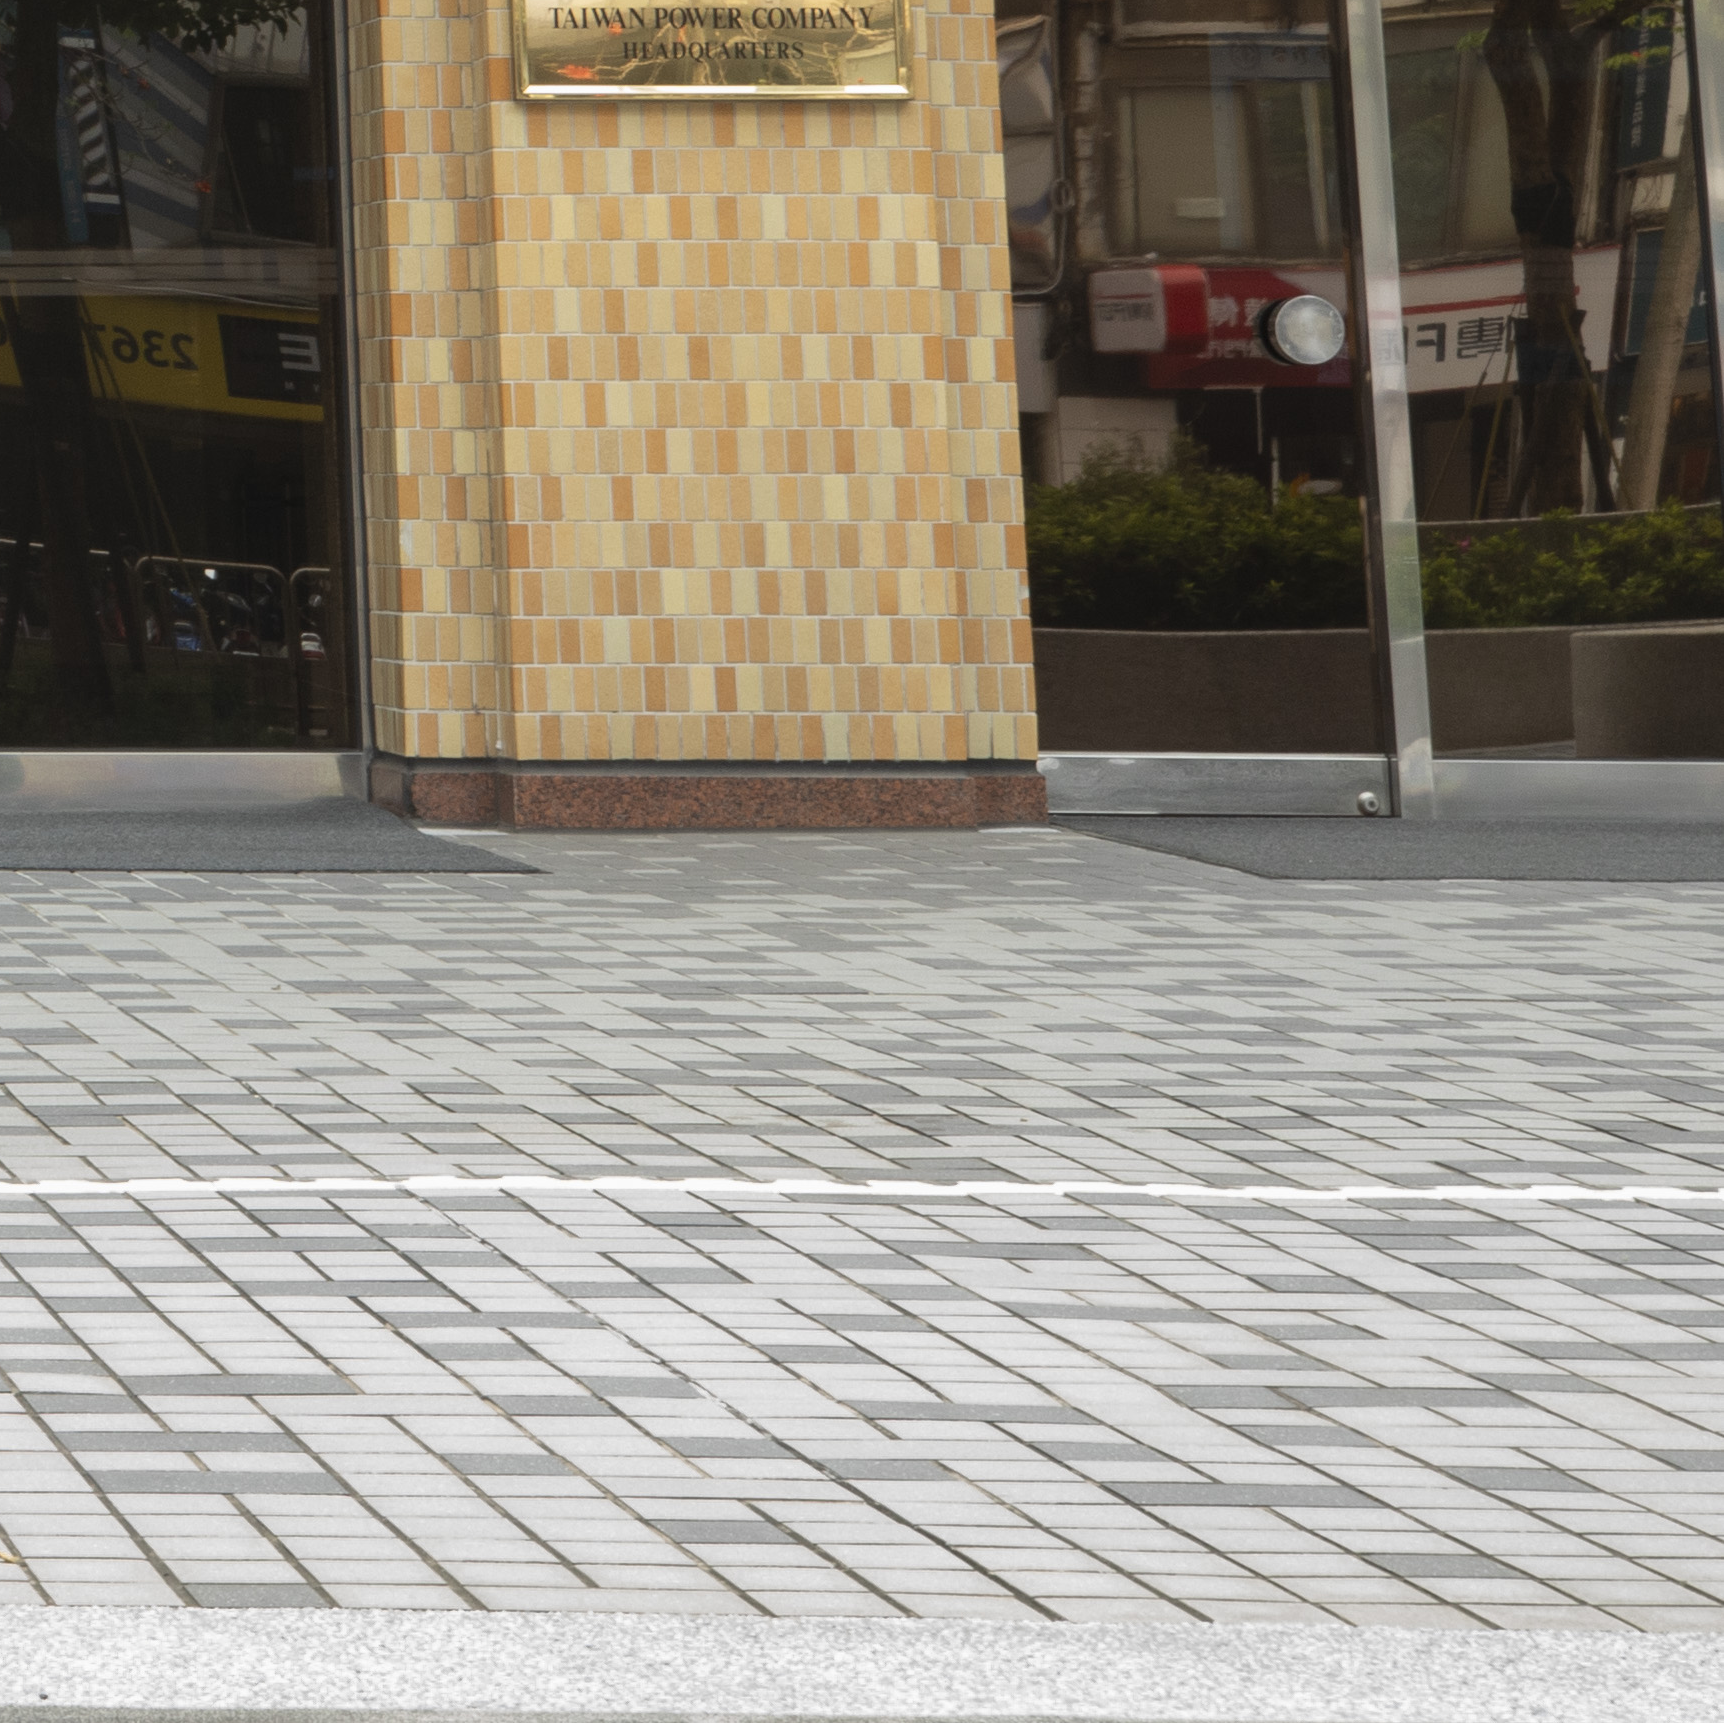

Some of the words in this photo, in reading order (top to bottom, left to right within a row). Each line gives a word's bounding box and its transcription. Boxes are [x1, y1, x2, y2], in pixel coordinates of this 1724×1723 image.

[548, 7, 646, 29] TAIWAN
[654, 7, 741, 29] POWER
[750, 7, 874, 29] COMPANY
[623, 42, 804, 63] HEADQUARTERS
